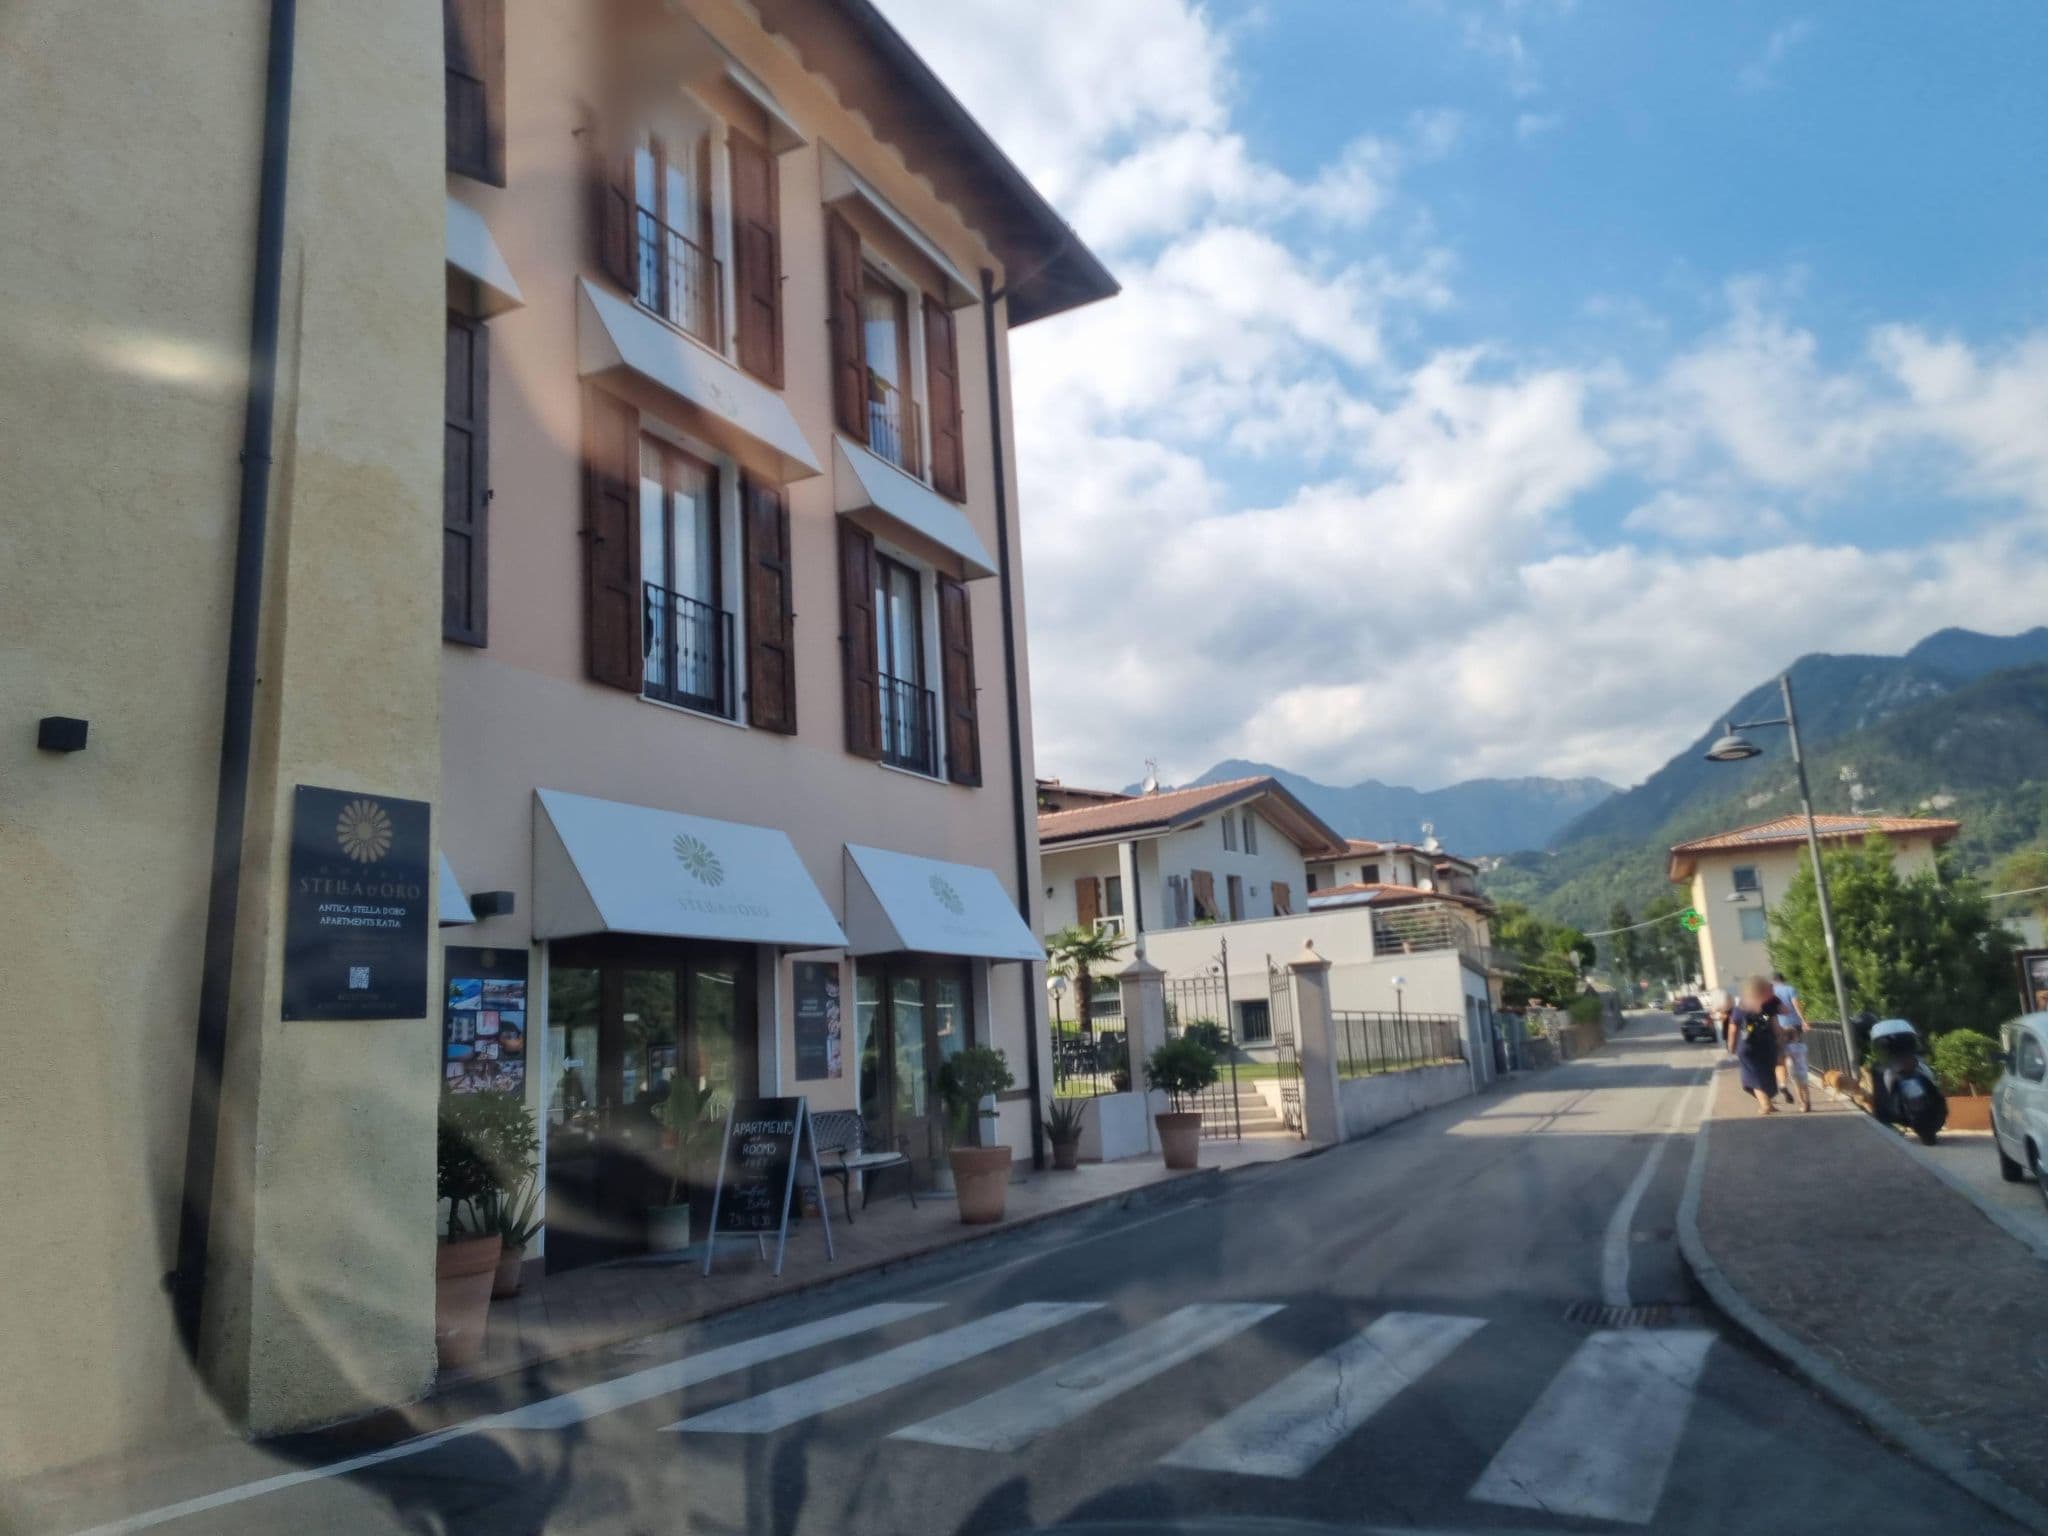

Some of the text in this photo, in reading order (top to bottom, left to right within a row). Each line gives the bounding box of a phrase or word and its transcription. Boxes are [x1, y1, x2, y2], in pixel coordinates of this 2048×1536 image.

[318, 903, 351, 914] ANTICA
[352, 904, 381, 915] STELLA
[319, 916, 374, 928] APARTMENTS
[732, 1120, 794, 1136] APARTMENTS
